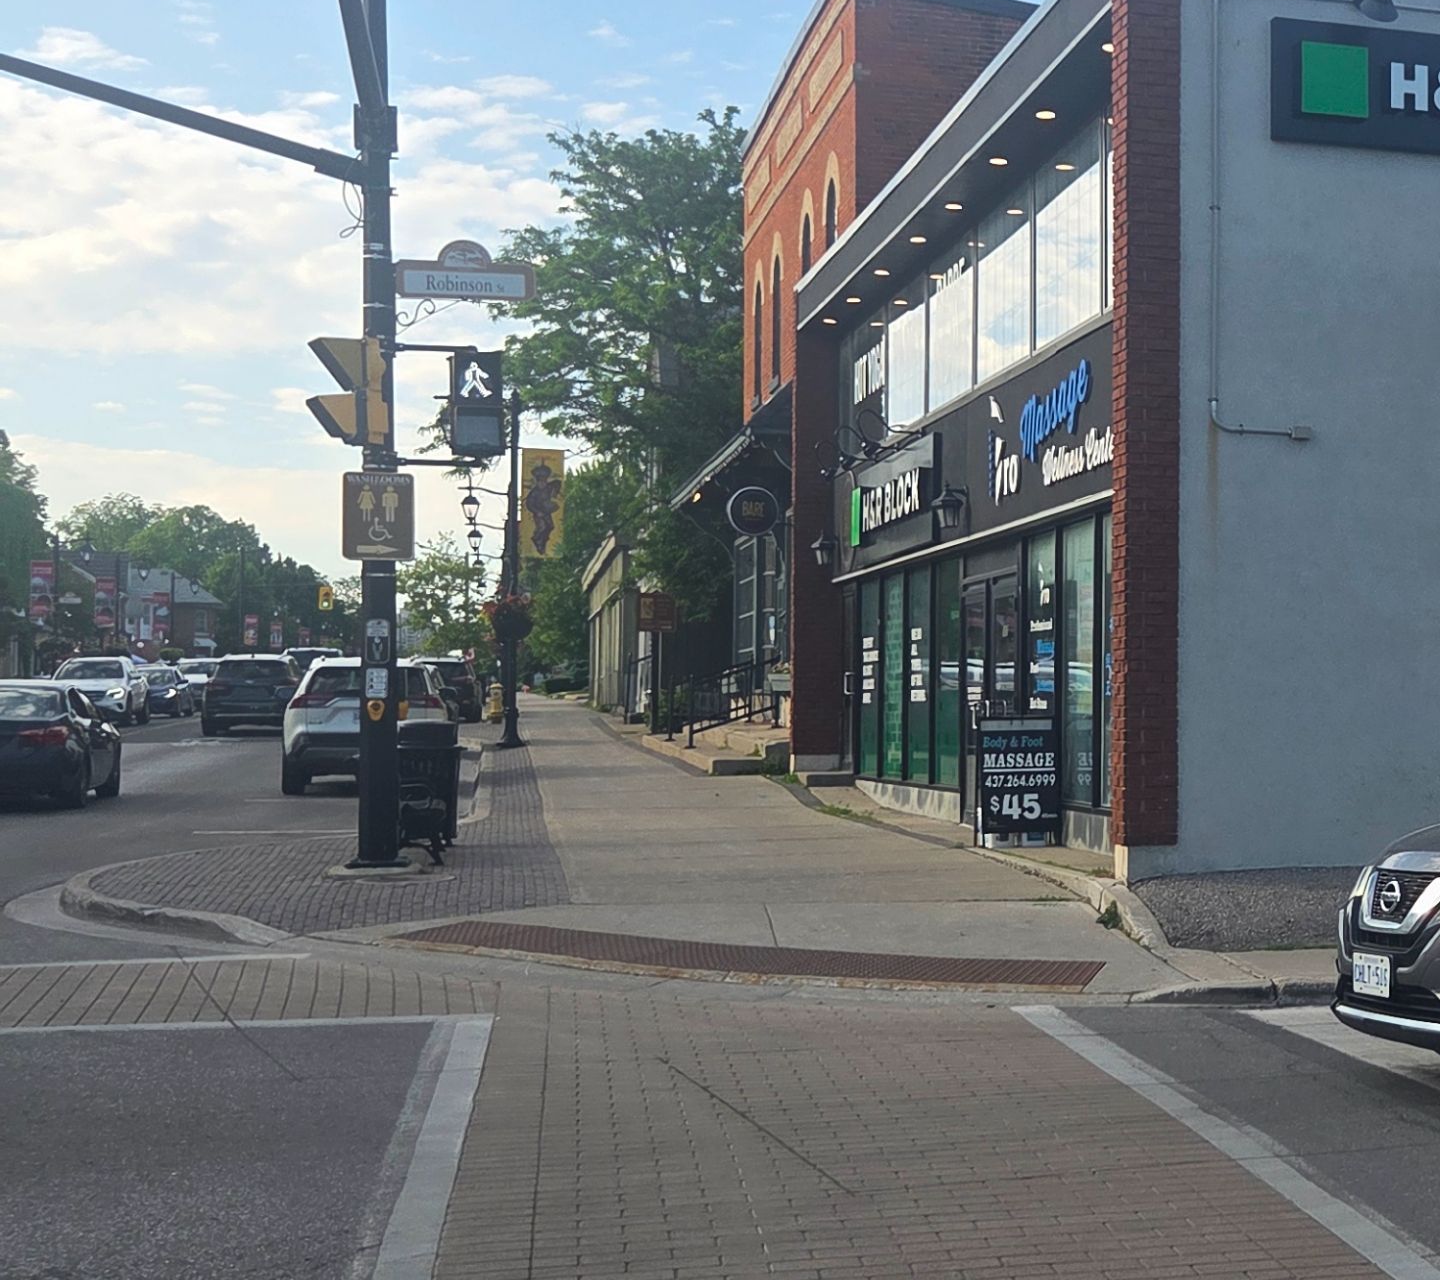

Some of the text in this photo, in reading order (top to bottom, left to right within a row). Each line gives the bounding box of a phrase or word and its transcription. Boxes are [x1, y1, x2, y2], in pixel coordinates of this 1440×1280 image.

[426, 275, 492, 293] Robinson
[1020, 359, 1088, 462] Massage
[1042, 445, 1084, 486] Wellness
[862, 468, 920, 533] H&R BLOCK
[983, 736, 1043, 750] Body & Foot
[983, 753, 1055, 768] MASSAGE
[985, 774, 1056, 787] 437.264.6999
[990, 793, 1041, 819] $45
